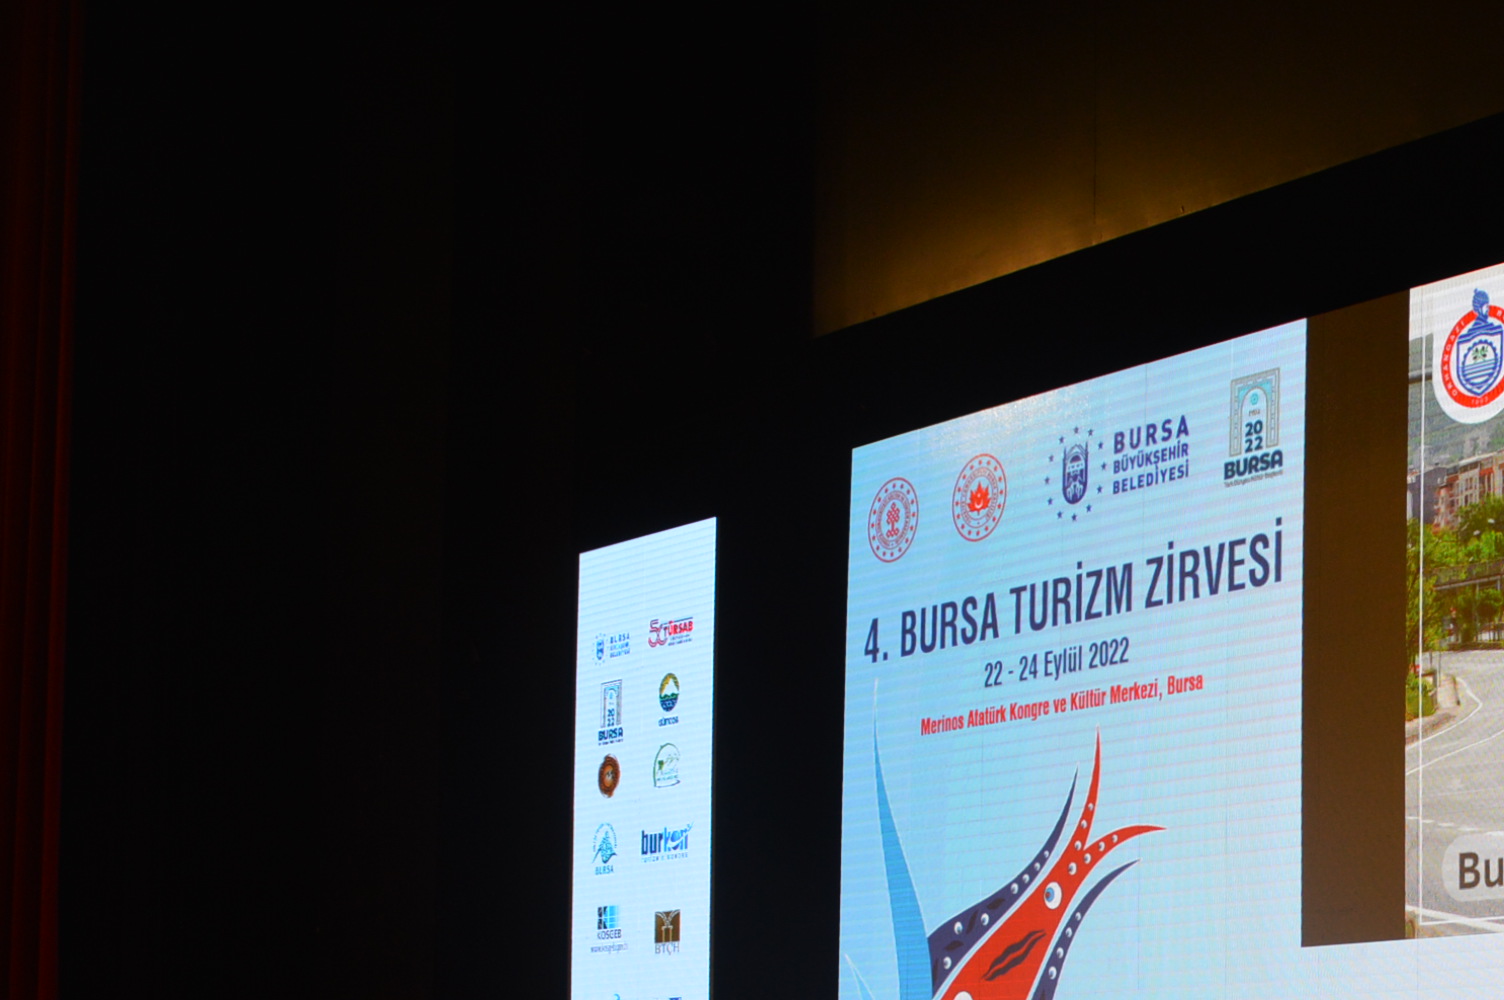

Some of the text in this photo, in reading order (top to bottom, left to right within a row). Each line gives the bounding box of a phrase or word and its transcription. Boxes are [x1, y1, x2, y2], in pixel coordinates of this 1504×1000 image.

[1113, 414, 1190, 455] BURSA
[1245, 419, 1263, 438] 20
[1245, 435, 1263, 454] 22
[1112, 440, 1189, 474] BÜYÜKŞEHİR
[1223, 448, 1284, 481] BURSA
[1112, 459, 1189, 495] BELEDİYESİ
[863, 516, 1283, 664] 4. BURSA TURİZM ZİRVESİ
[984, 660, 1003, 689] 22
[1018, 653, 1038, 682] 24
[1044, 644, 1083, 681] Eylül
[1089, 636, 1130, 671] 2022
[920, 673, 1204, 736] Merinos Atatürk Kongre ve Kültür Merkezi, Bursa
[598, 727, 624, 742] BURSA
